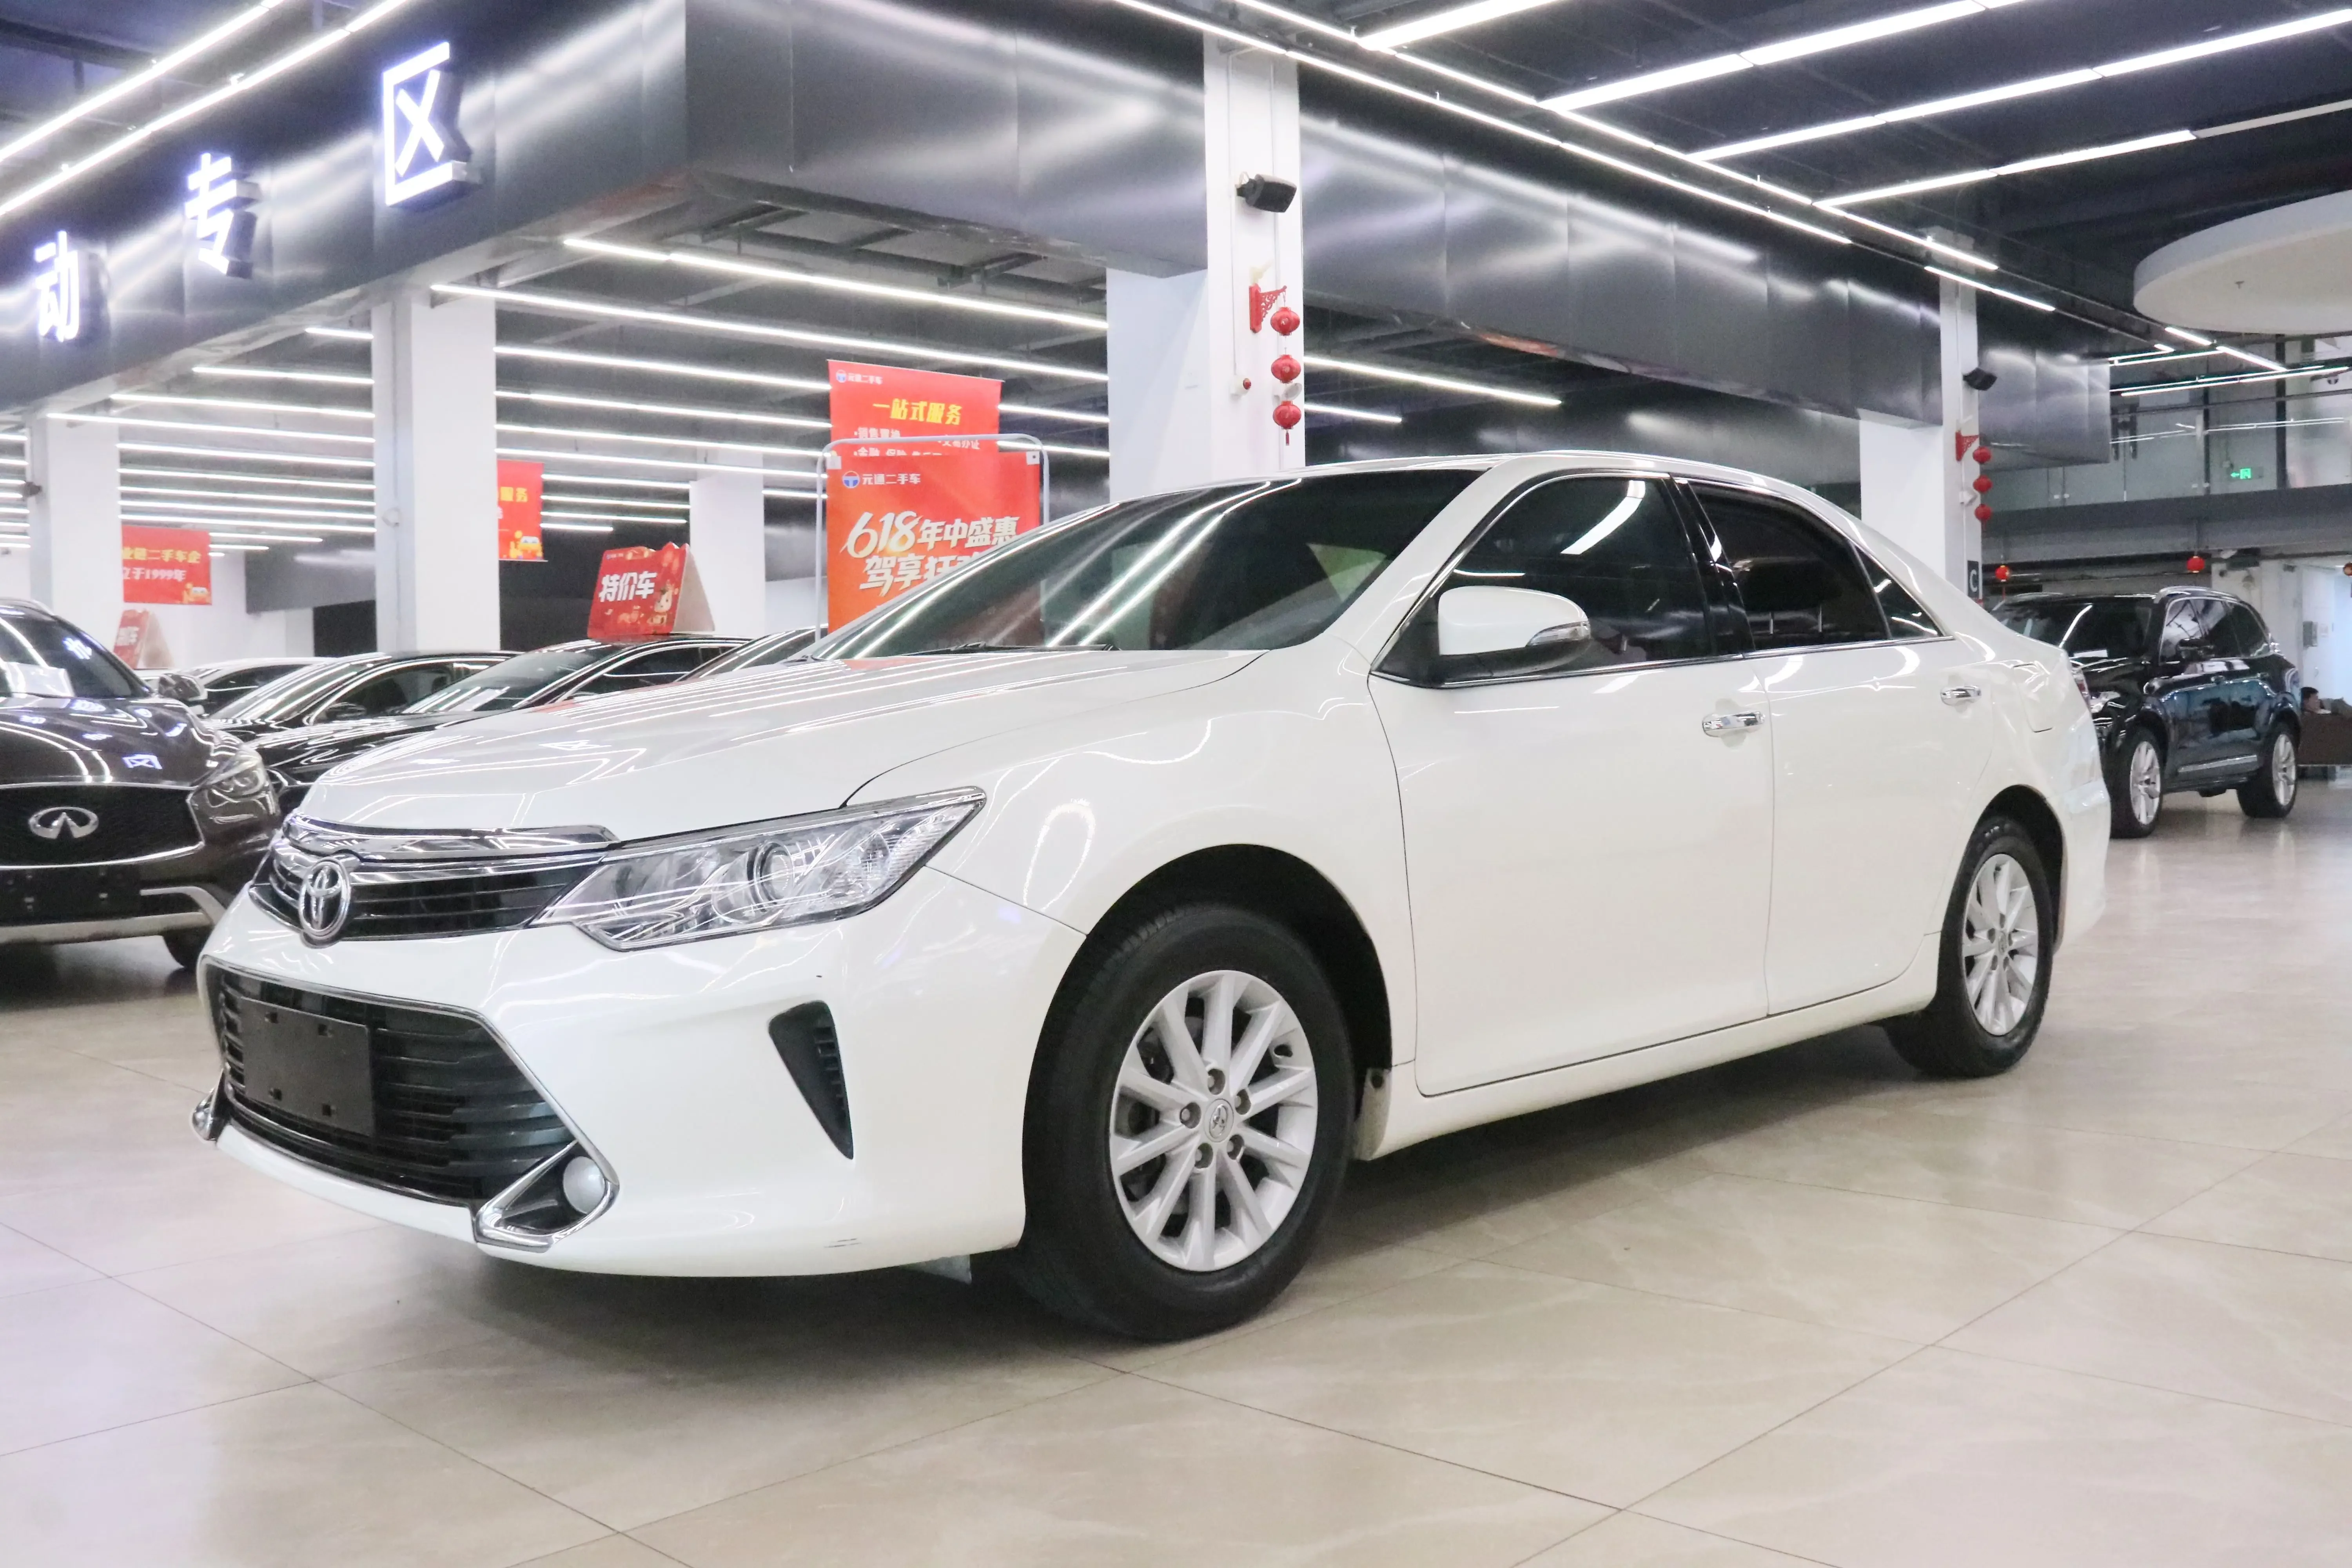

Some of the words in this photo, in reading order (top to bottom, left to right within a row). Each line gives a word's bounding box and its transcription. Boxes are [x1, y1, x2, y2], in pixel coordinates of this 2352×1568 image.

[873, 399, 962, 426] 一站式服务
[862, 473, 921, 485] 元通二手车
[840, 510, 1020, 558] 618年中盛惠
[599, 571, 657, 603] 特价车
